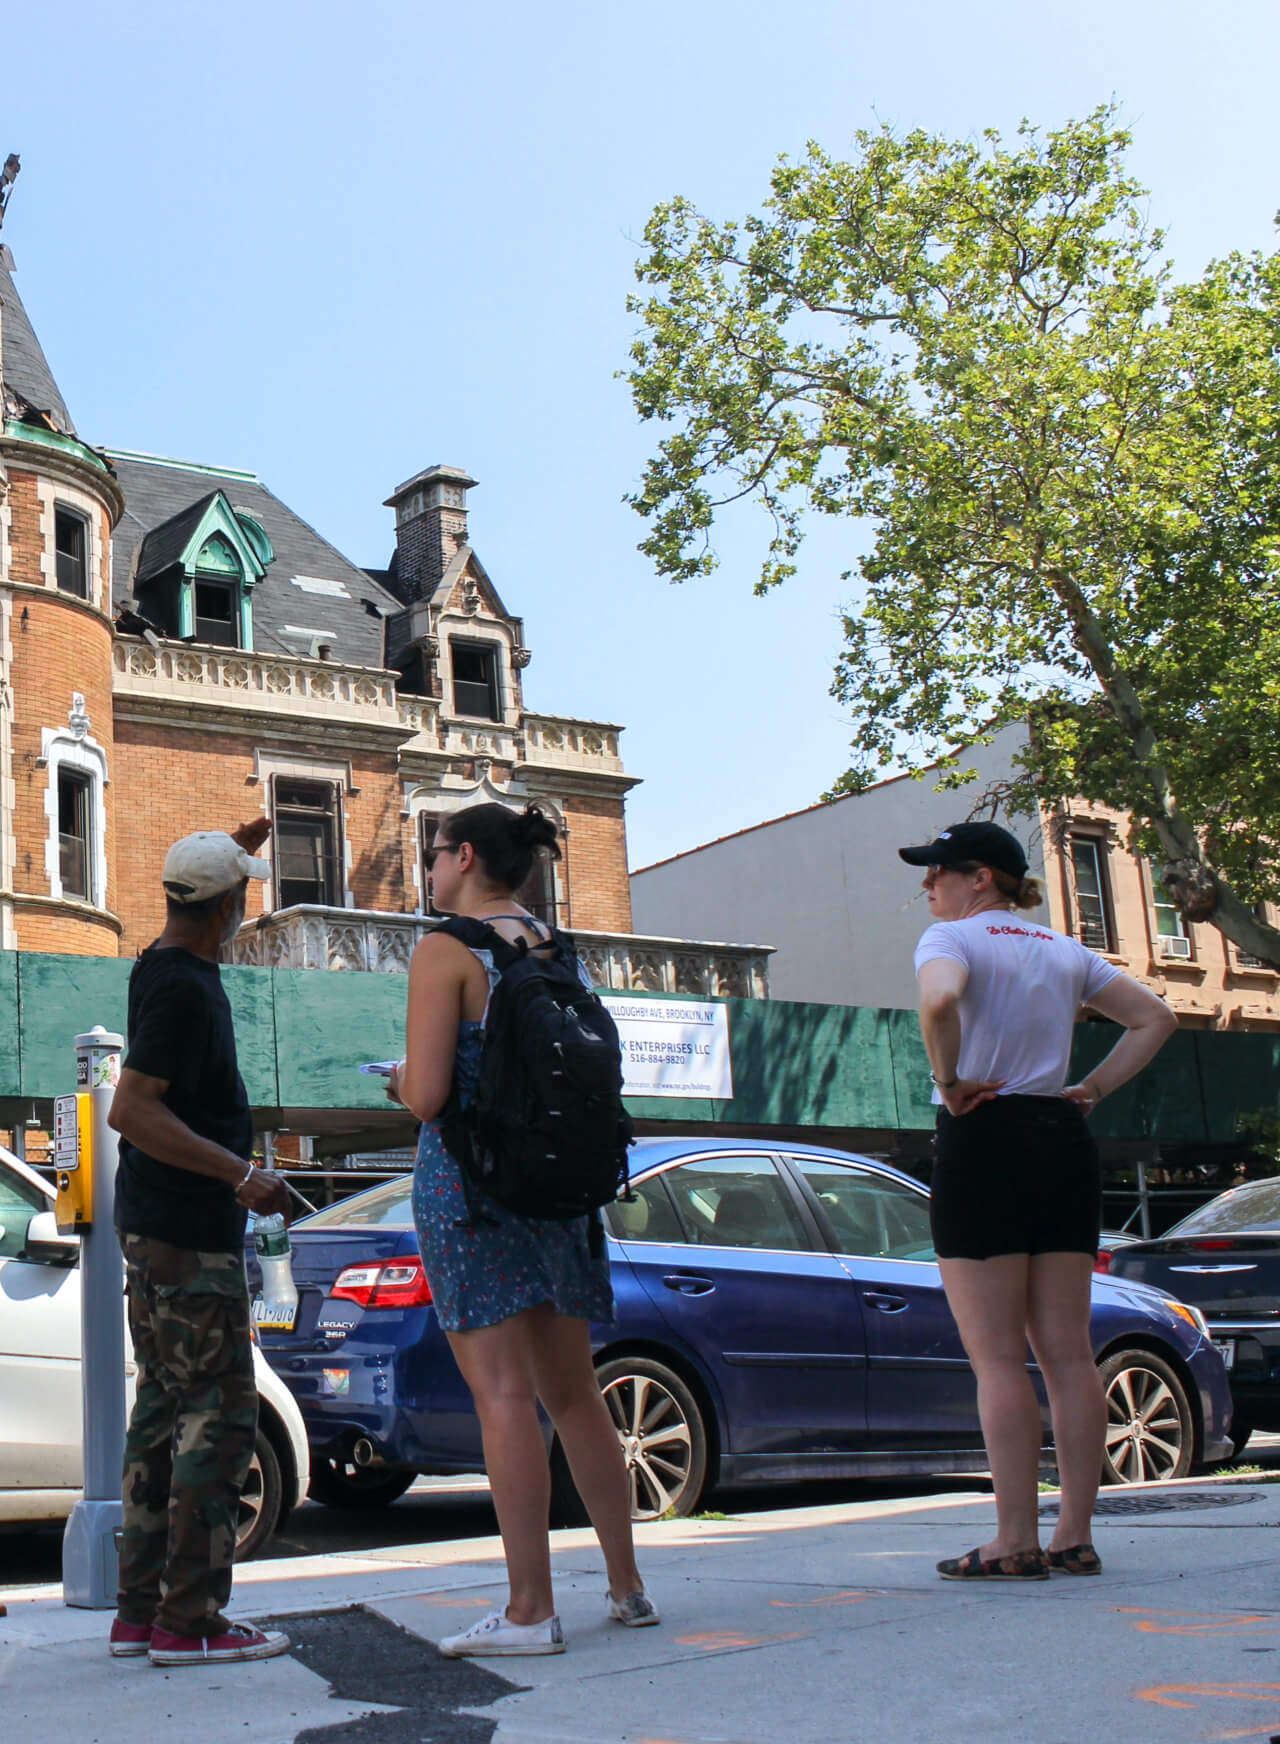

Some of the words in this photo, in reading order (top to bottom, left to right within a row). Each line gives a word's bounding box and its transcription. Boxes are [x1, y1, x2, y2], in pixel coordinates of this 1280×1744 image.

[704, 1011, 714, 1021] NY
[629, 1041, 692, 1055] ENTERPRISES
[694, 1045, 711, 1055] LLC
[318, 1321, 357, 1329] LEGACY
